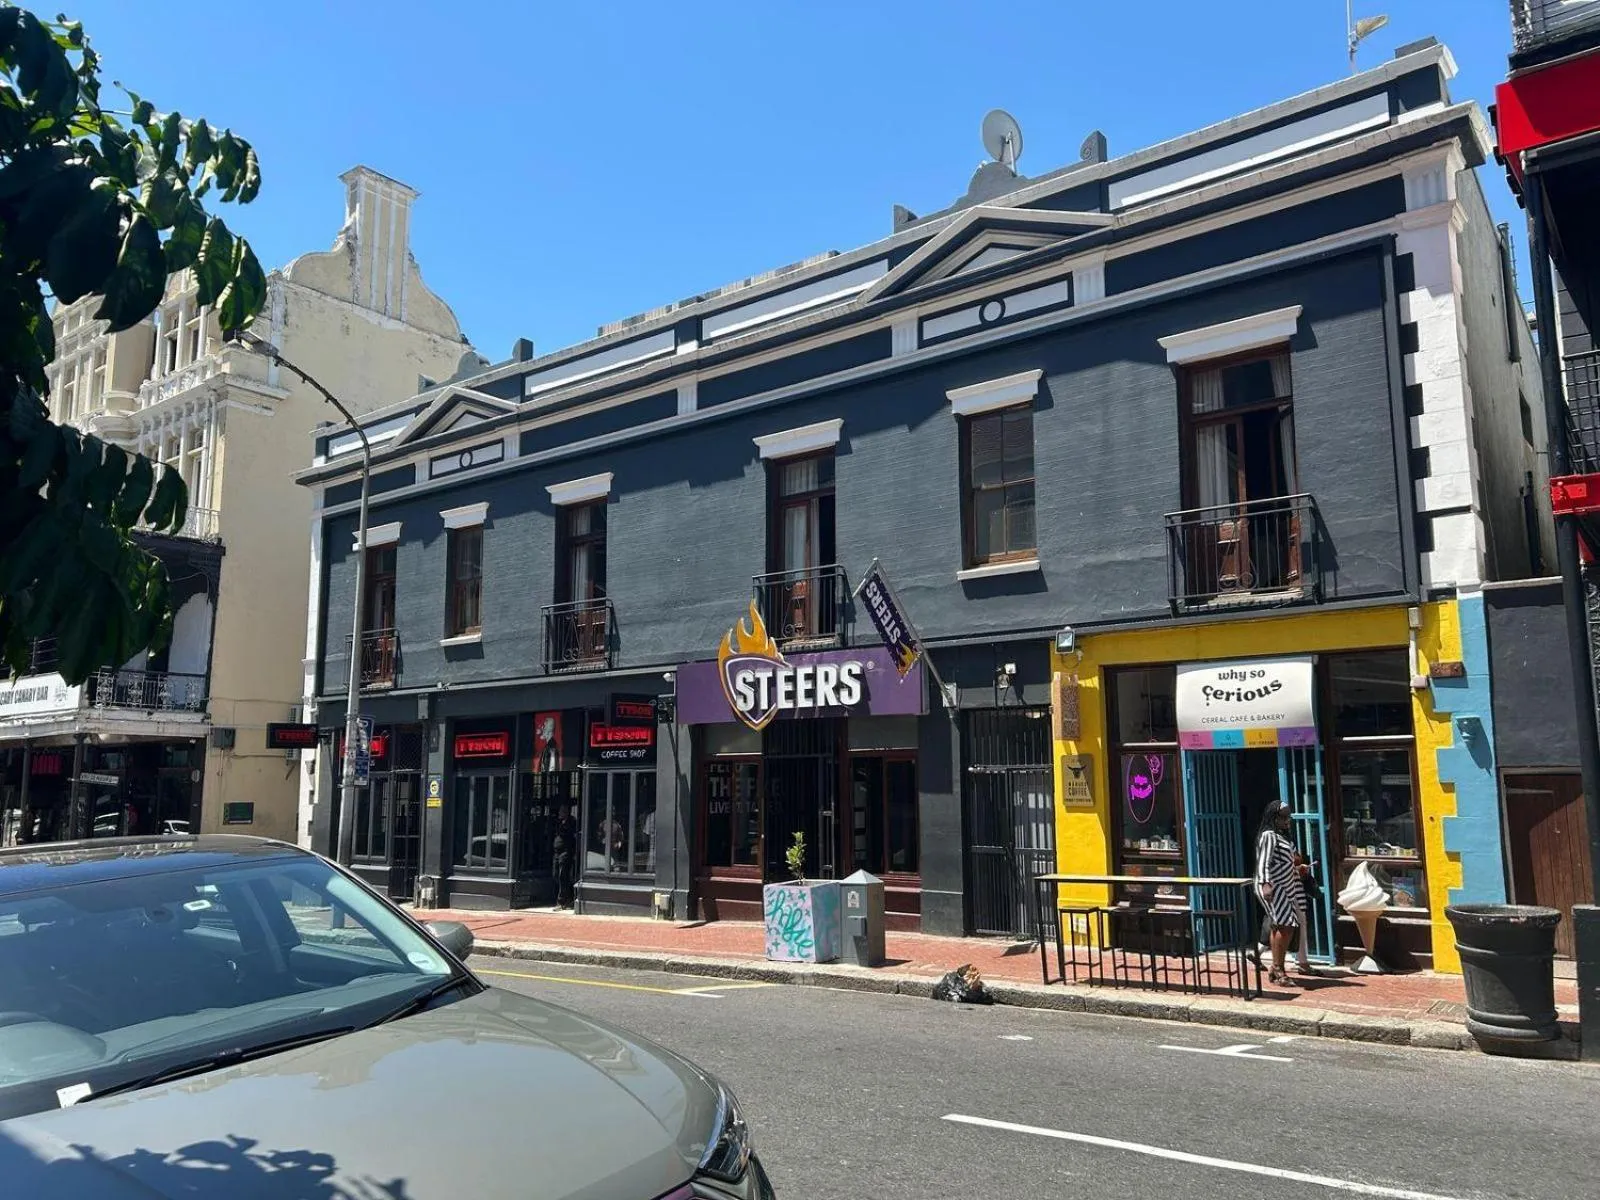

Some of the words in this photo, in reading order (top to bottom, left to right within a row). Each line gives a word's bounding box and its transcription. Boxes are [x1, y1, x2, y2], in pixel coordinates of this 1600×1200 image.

[866, 581, 901, 644] STEERS
[1218, 669, 1247, 681] why
[1250, 669, 1265, 678] so
[735, 660, 864, 713] STEERS
[1201, 716, 1228, 724] CEREAL
[1257, 713, 1286, 721] BAKERY
[600, 750, 628, 759] COFFEE
[629, 749, 647, 758] SHOP
